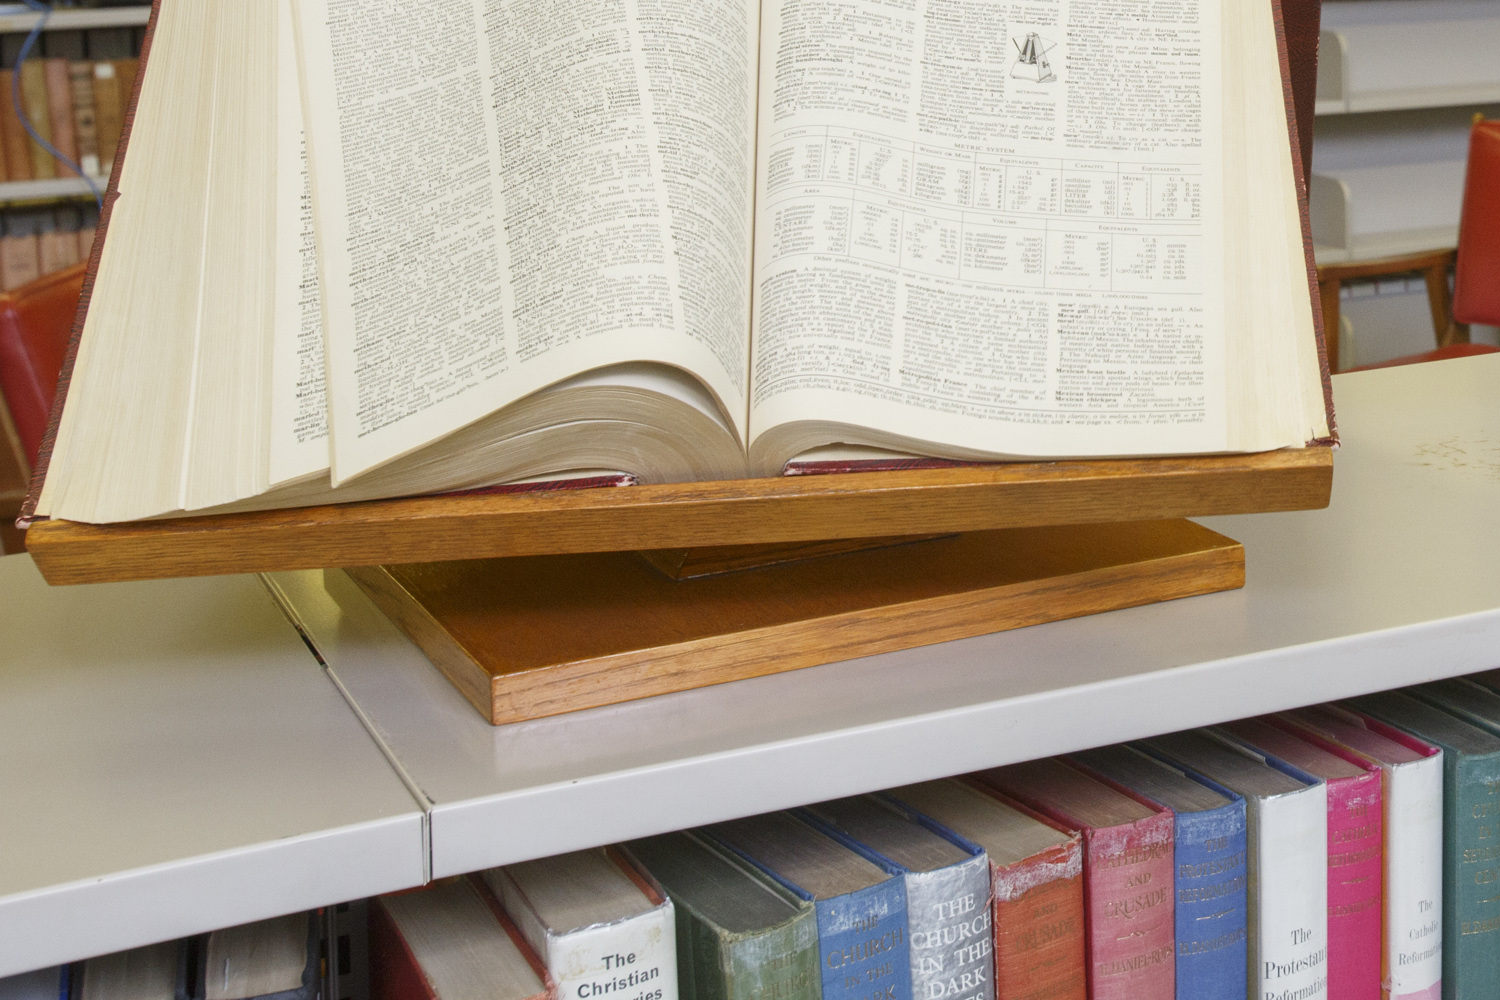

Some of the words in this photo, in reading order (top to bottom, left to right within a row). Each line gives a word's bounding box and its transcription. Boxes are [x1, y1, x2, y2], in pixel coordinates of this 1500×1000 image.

[953, 142, 983, 153] METRIC
[1097, 838, 1171, 871] CATHEDRAL
[1179, 850, 1247, 879] PROTESTANT
[1125, 873, 1152, 889] AND
[933, 893, 976, 921] THE
[1105, 887, 1167, 920] CRUSADE
[853, 915, 879, 934] THE
[911, 909, 992, 950] CHURCH
[601, 952, 636, 972] The
[827, 928, 903, 970] CHURCH
[919, 955, 944, 975] IN
[954, 937, 992, 967] THE
[577, 966, 660, 999] Christian
[844, 974, 861, 990] IN
[866, 962, 894, 982] THE
[928, 965, 987, 1000] DARK
